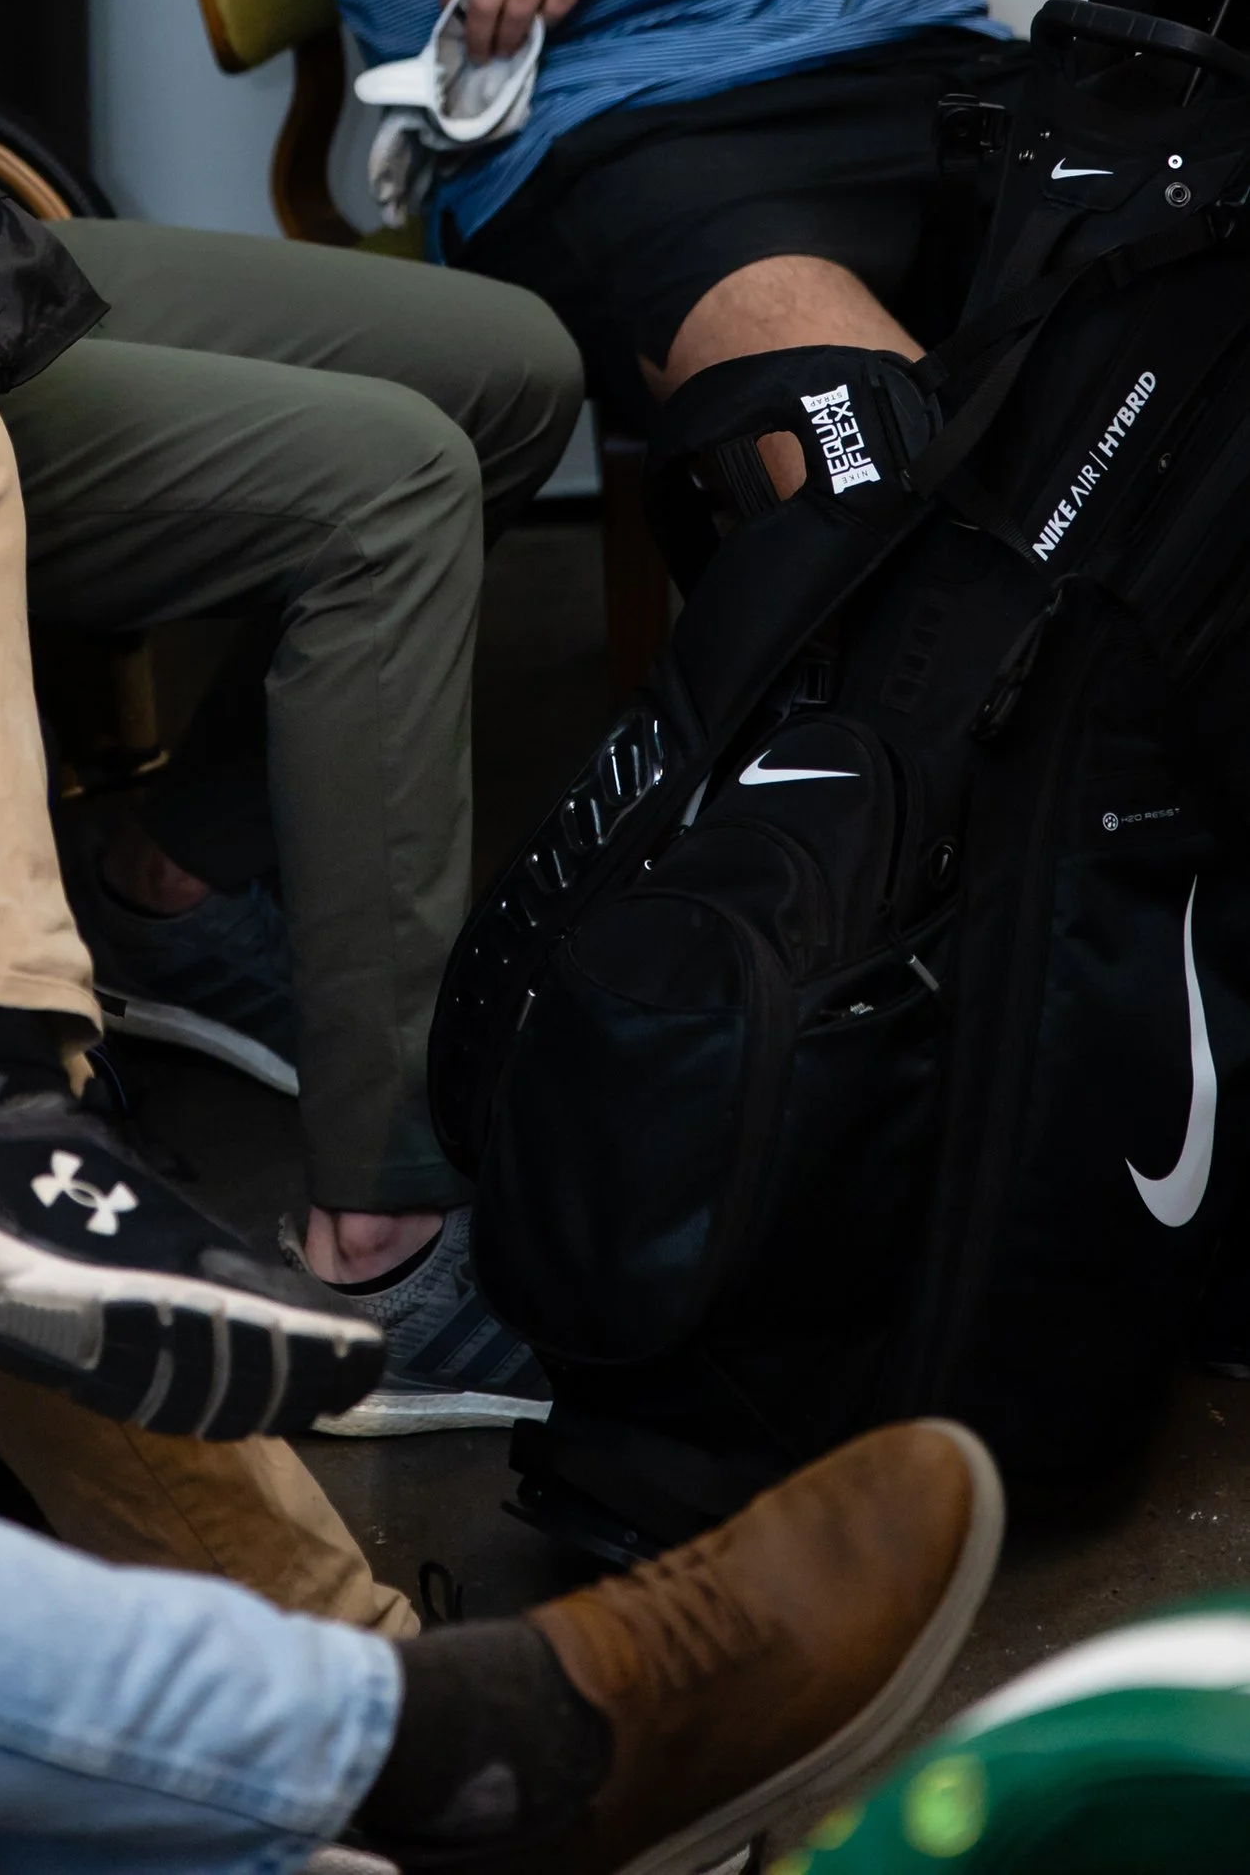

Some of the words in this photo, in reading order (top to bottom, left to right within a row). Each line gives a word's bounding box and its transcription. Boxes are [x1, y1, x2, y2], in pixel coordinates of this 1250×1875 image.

[810, 391, 844, 408] STRAP
[811, 407, 850, 475] EQUA
[829, 400, 872, 468] FLEX
[1032, 498, 1077, 562] NIKE
[1070, 464, 1101, 508] AIR
[1097, 370, 1157, 458] HYBRID
[841, 470, 869, 485] NIKE
